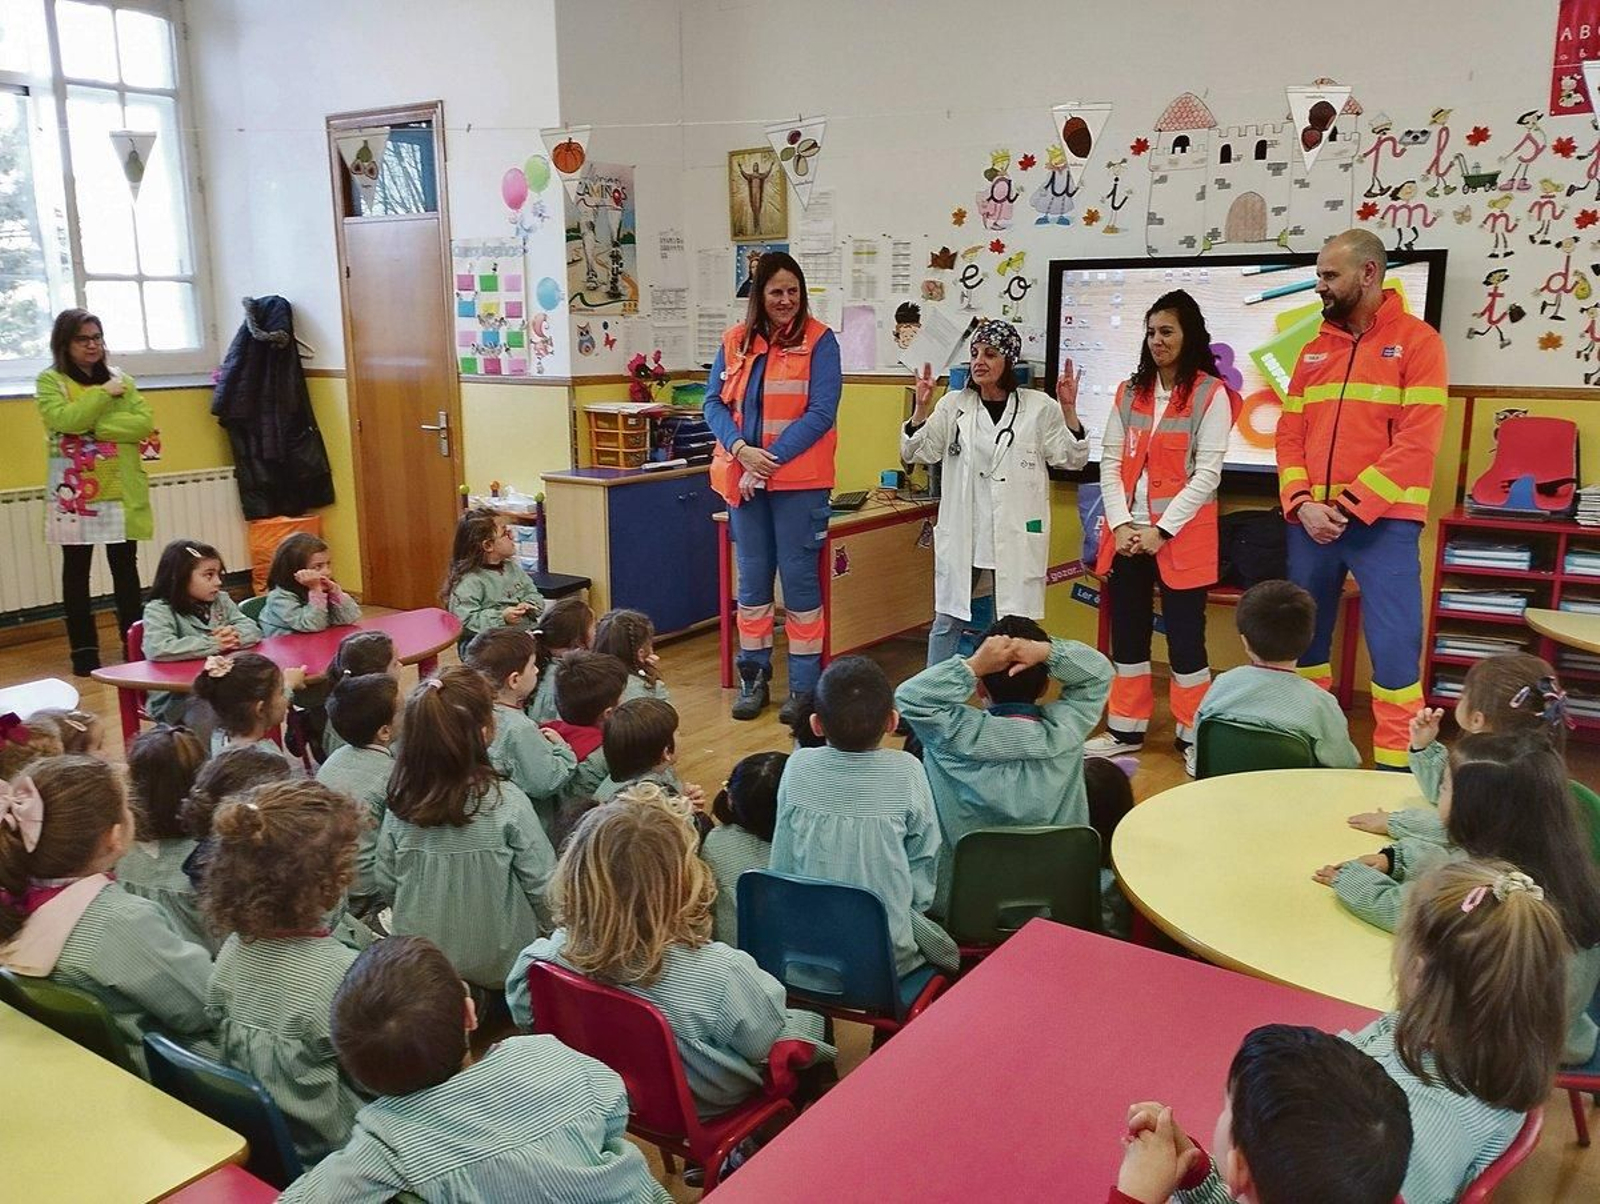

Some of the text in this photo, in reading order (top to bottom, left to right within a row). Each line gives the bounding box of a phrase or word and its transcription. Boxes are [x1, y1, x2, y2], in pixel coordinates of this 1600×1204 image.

[1559, 27, 1573, 42] A
[1579, 24, 1591, 40] B
[986, 176, 1020, 204] a
[959, 263, 984, 290] e
